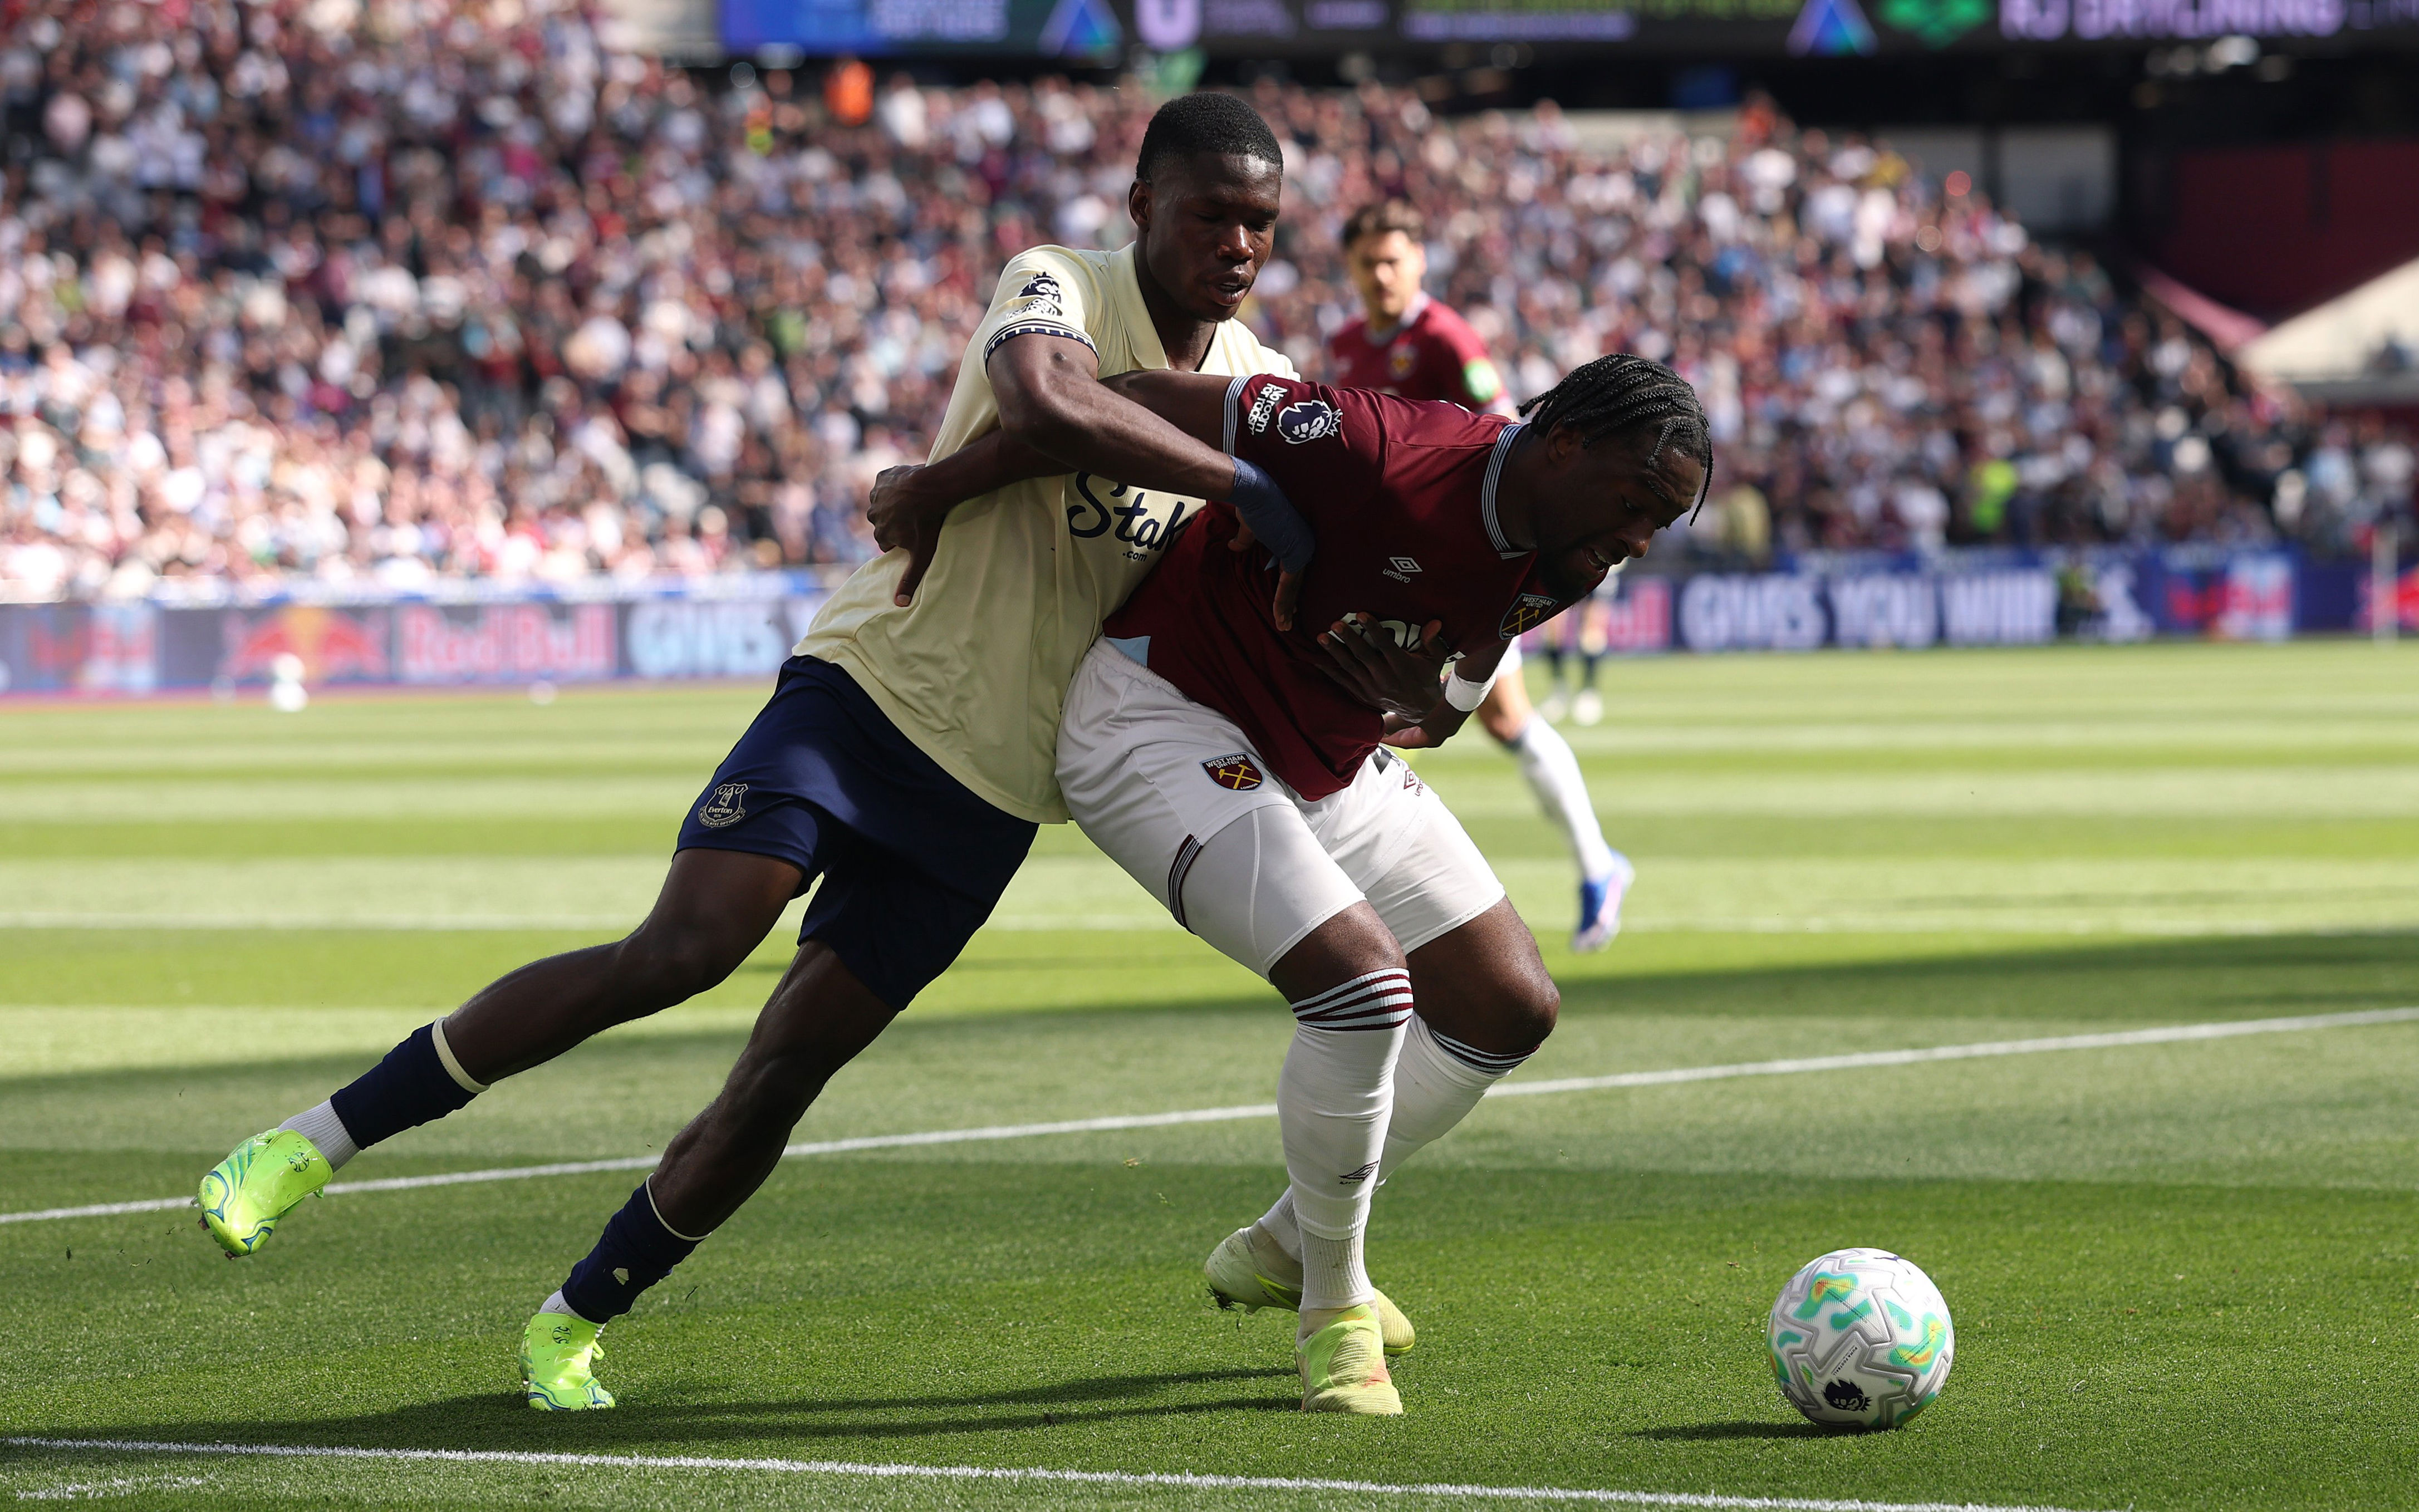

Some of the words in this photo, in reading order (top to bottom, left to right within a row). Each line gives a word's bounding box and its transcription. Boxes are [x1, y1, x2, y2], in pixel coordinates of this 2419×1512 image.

[1269, 386, 1288, 401] No
[1255, 400, 1275, 433] room
[1067, 471, 1192, 551] Stak
[1122, 550, 1147, 562] .com
[1383, 568, 1410, 583] umbro
[1206, 758, 1225, 768] WEST
[1216, 760, 1240, 769] UNITED
